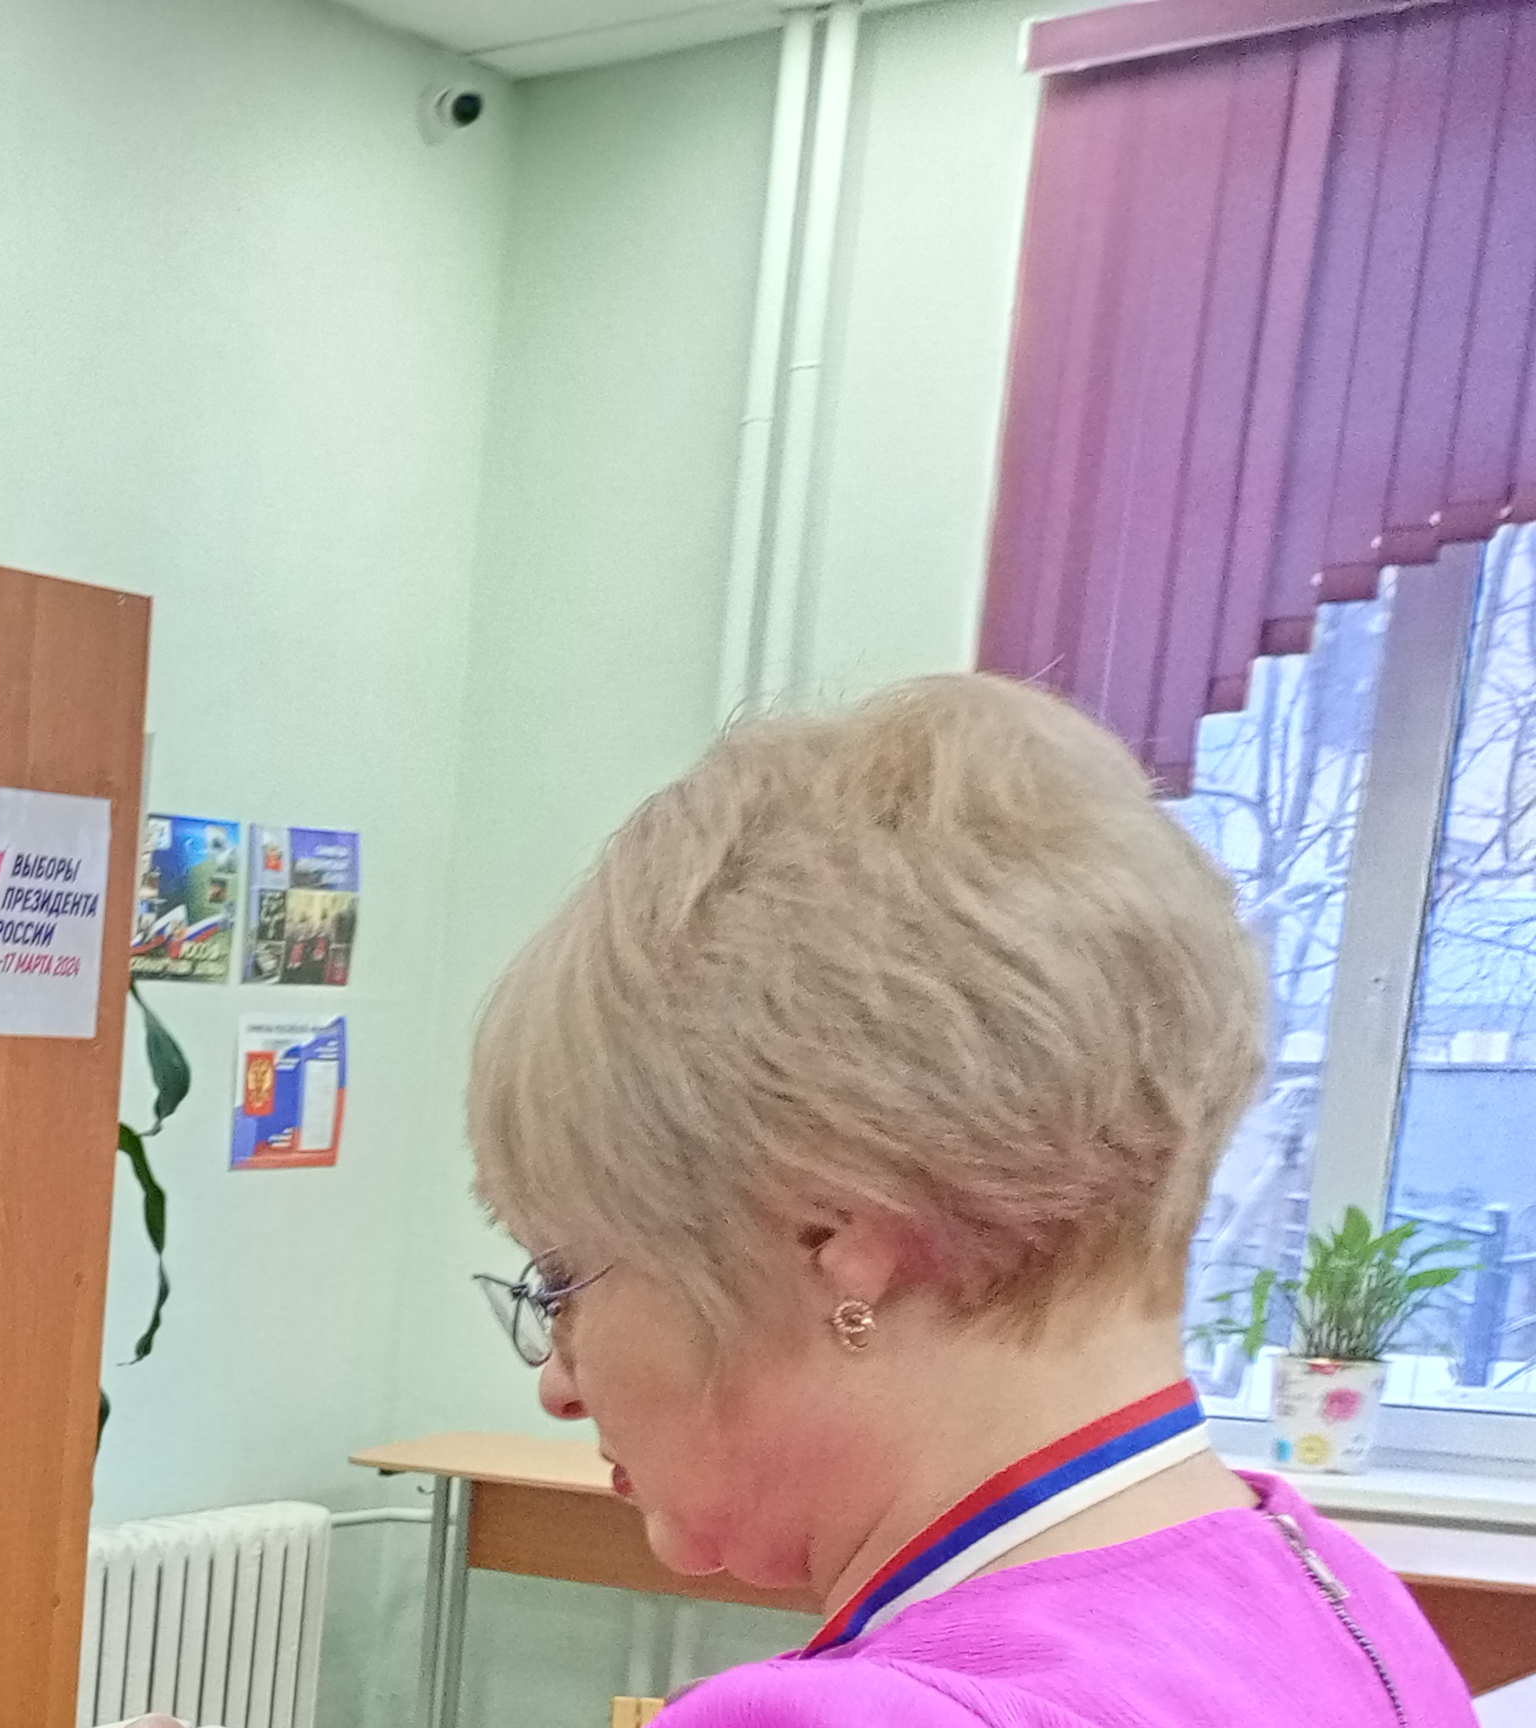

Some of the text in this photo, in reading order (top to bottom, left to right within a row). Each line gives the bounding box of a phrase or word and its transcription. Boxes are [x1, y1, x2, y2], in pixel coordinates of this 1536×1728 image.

[11, 853, 82, 883] ВЫБОРЫ
[0, 886, 100, 919] ПРЕЗИДЕНТА
[14, 952, 53, 976] МАРТА
[53, 955, 81, 977] 2024
